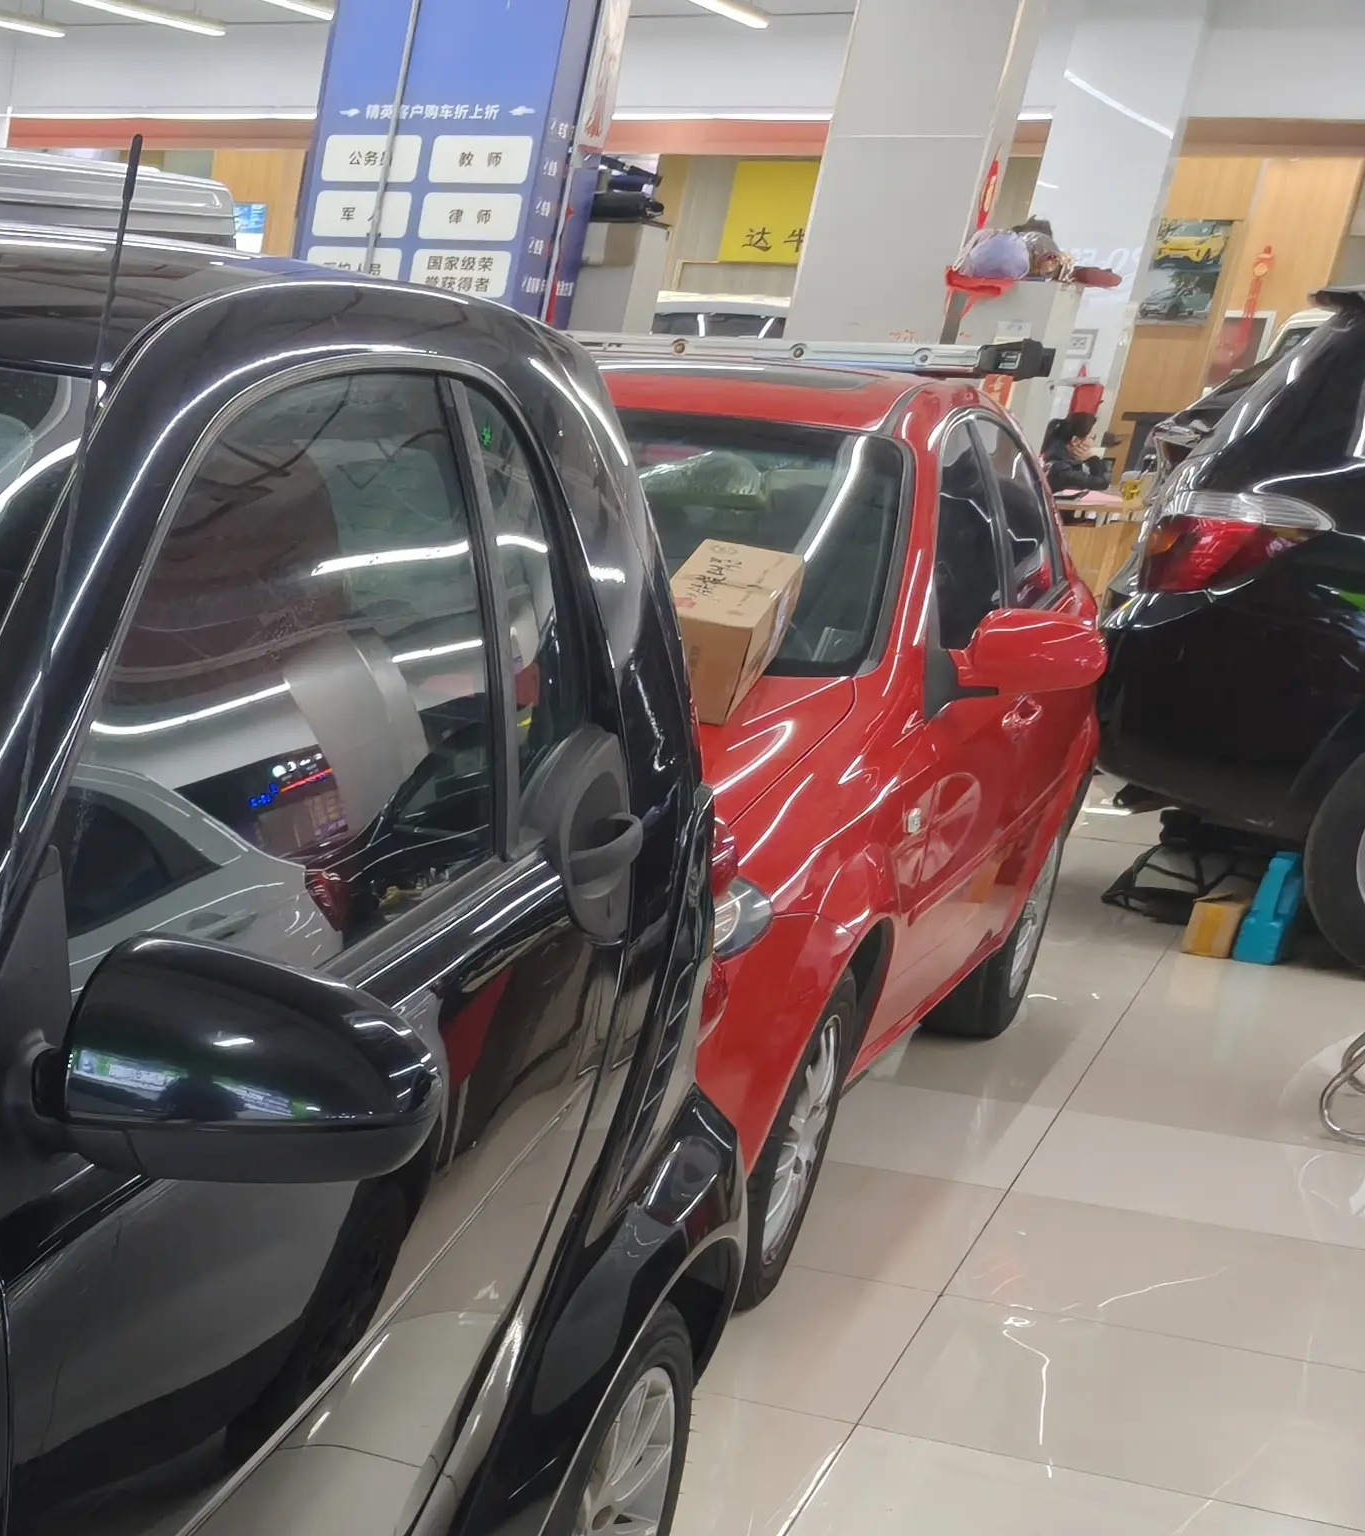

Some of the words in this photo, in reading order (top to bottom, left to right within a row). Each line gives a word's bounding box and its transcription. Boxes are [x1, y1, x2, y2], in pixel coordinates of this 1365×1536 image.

[365, 104, 500, 120] 精英客户购车折上折
[426, 255, 494, 272] 国家级荣
